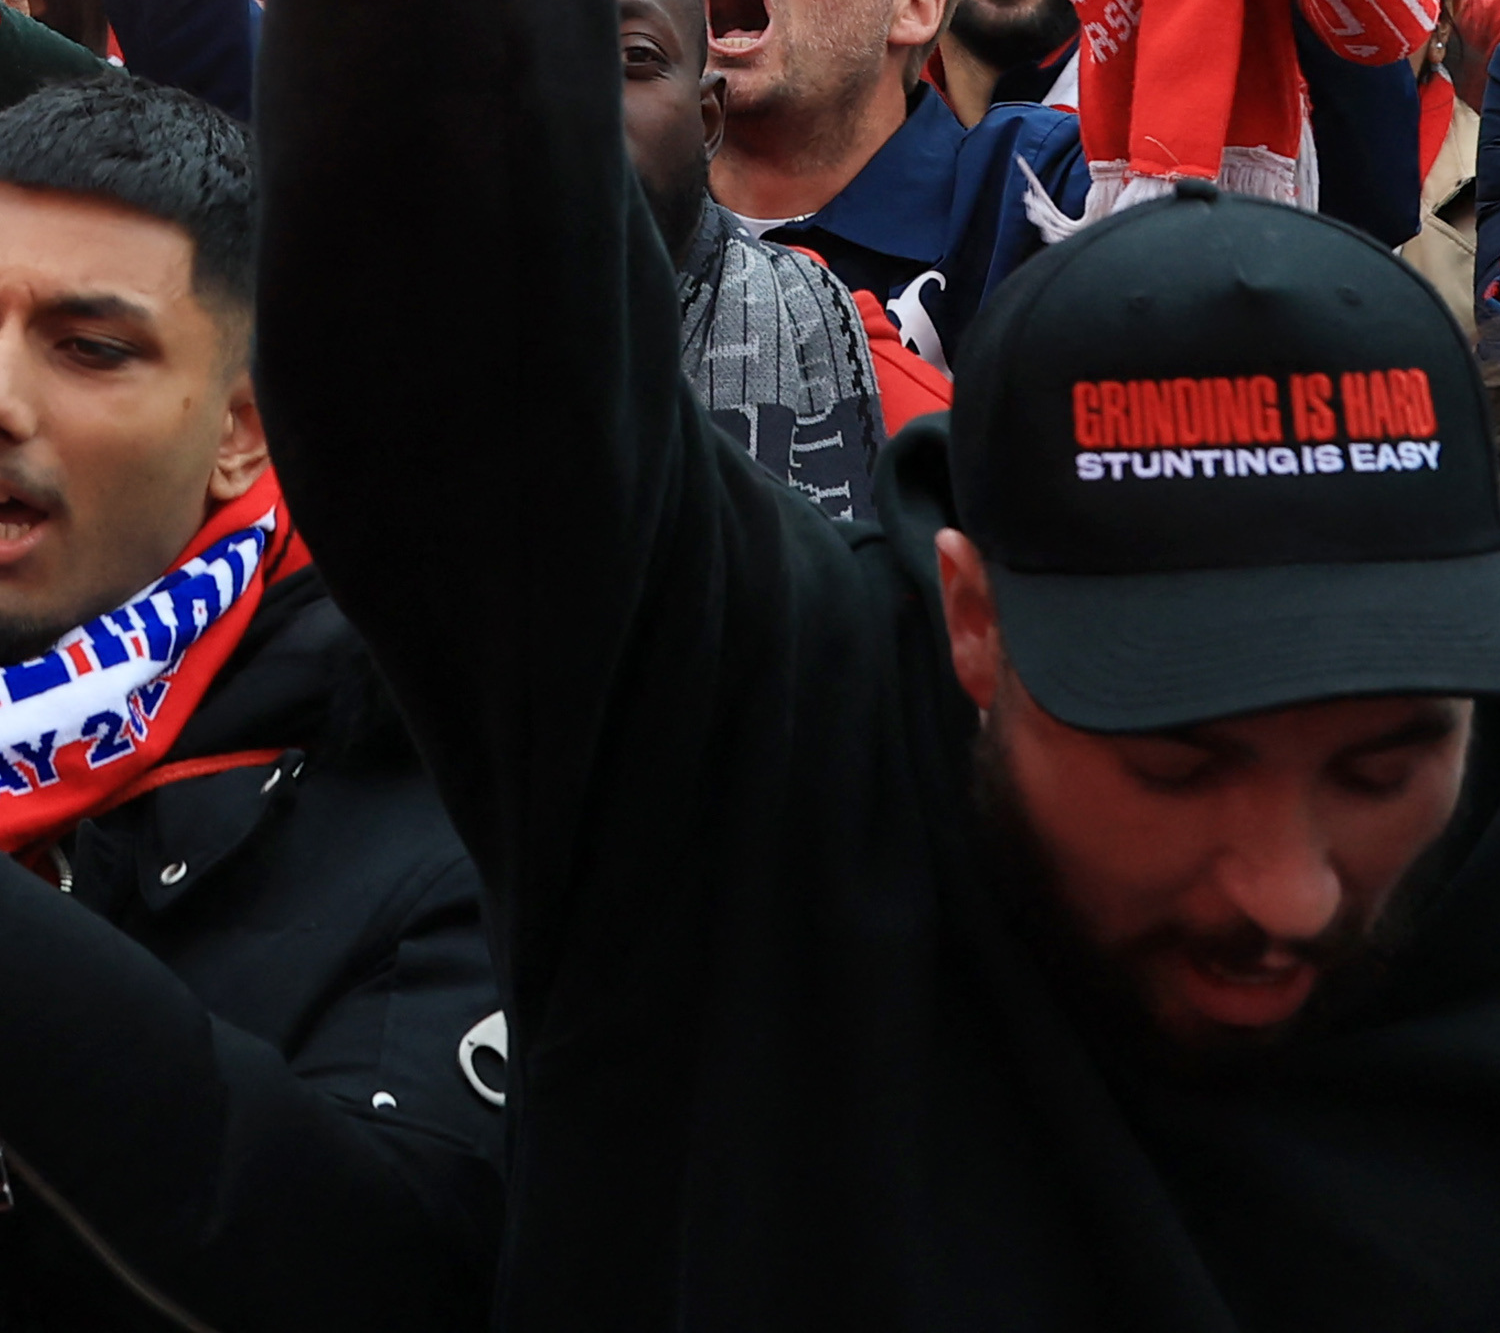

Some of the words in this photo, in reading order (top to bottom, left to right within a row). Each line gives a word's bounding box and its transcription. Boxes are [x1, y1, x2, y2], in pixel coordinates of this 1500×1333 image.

[1072, 374, 1283, 449] GRINDING
[1289, 371, 1336, 443] IS
[1340, 367, 1438, 441] HARD
[1074, 445, 1300, 481] STUNTING
[1302, 444, 1344, 475] IS
[1350, 440, 1441, 475] EASY
